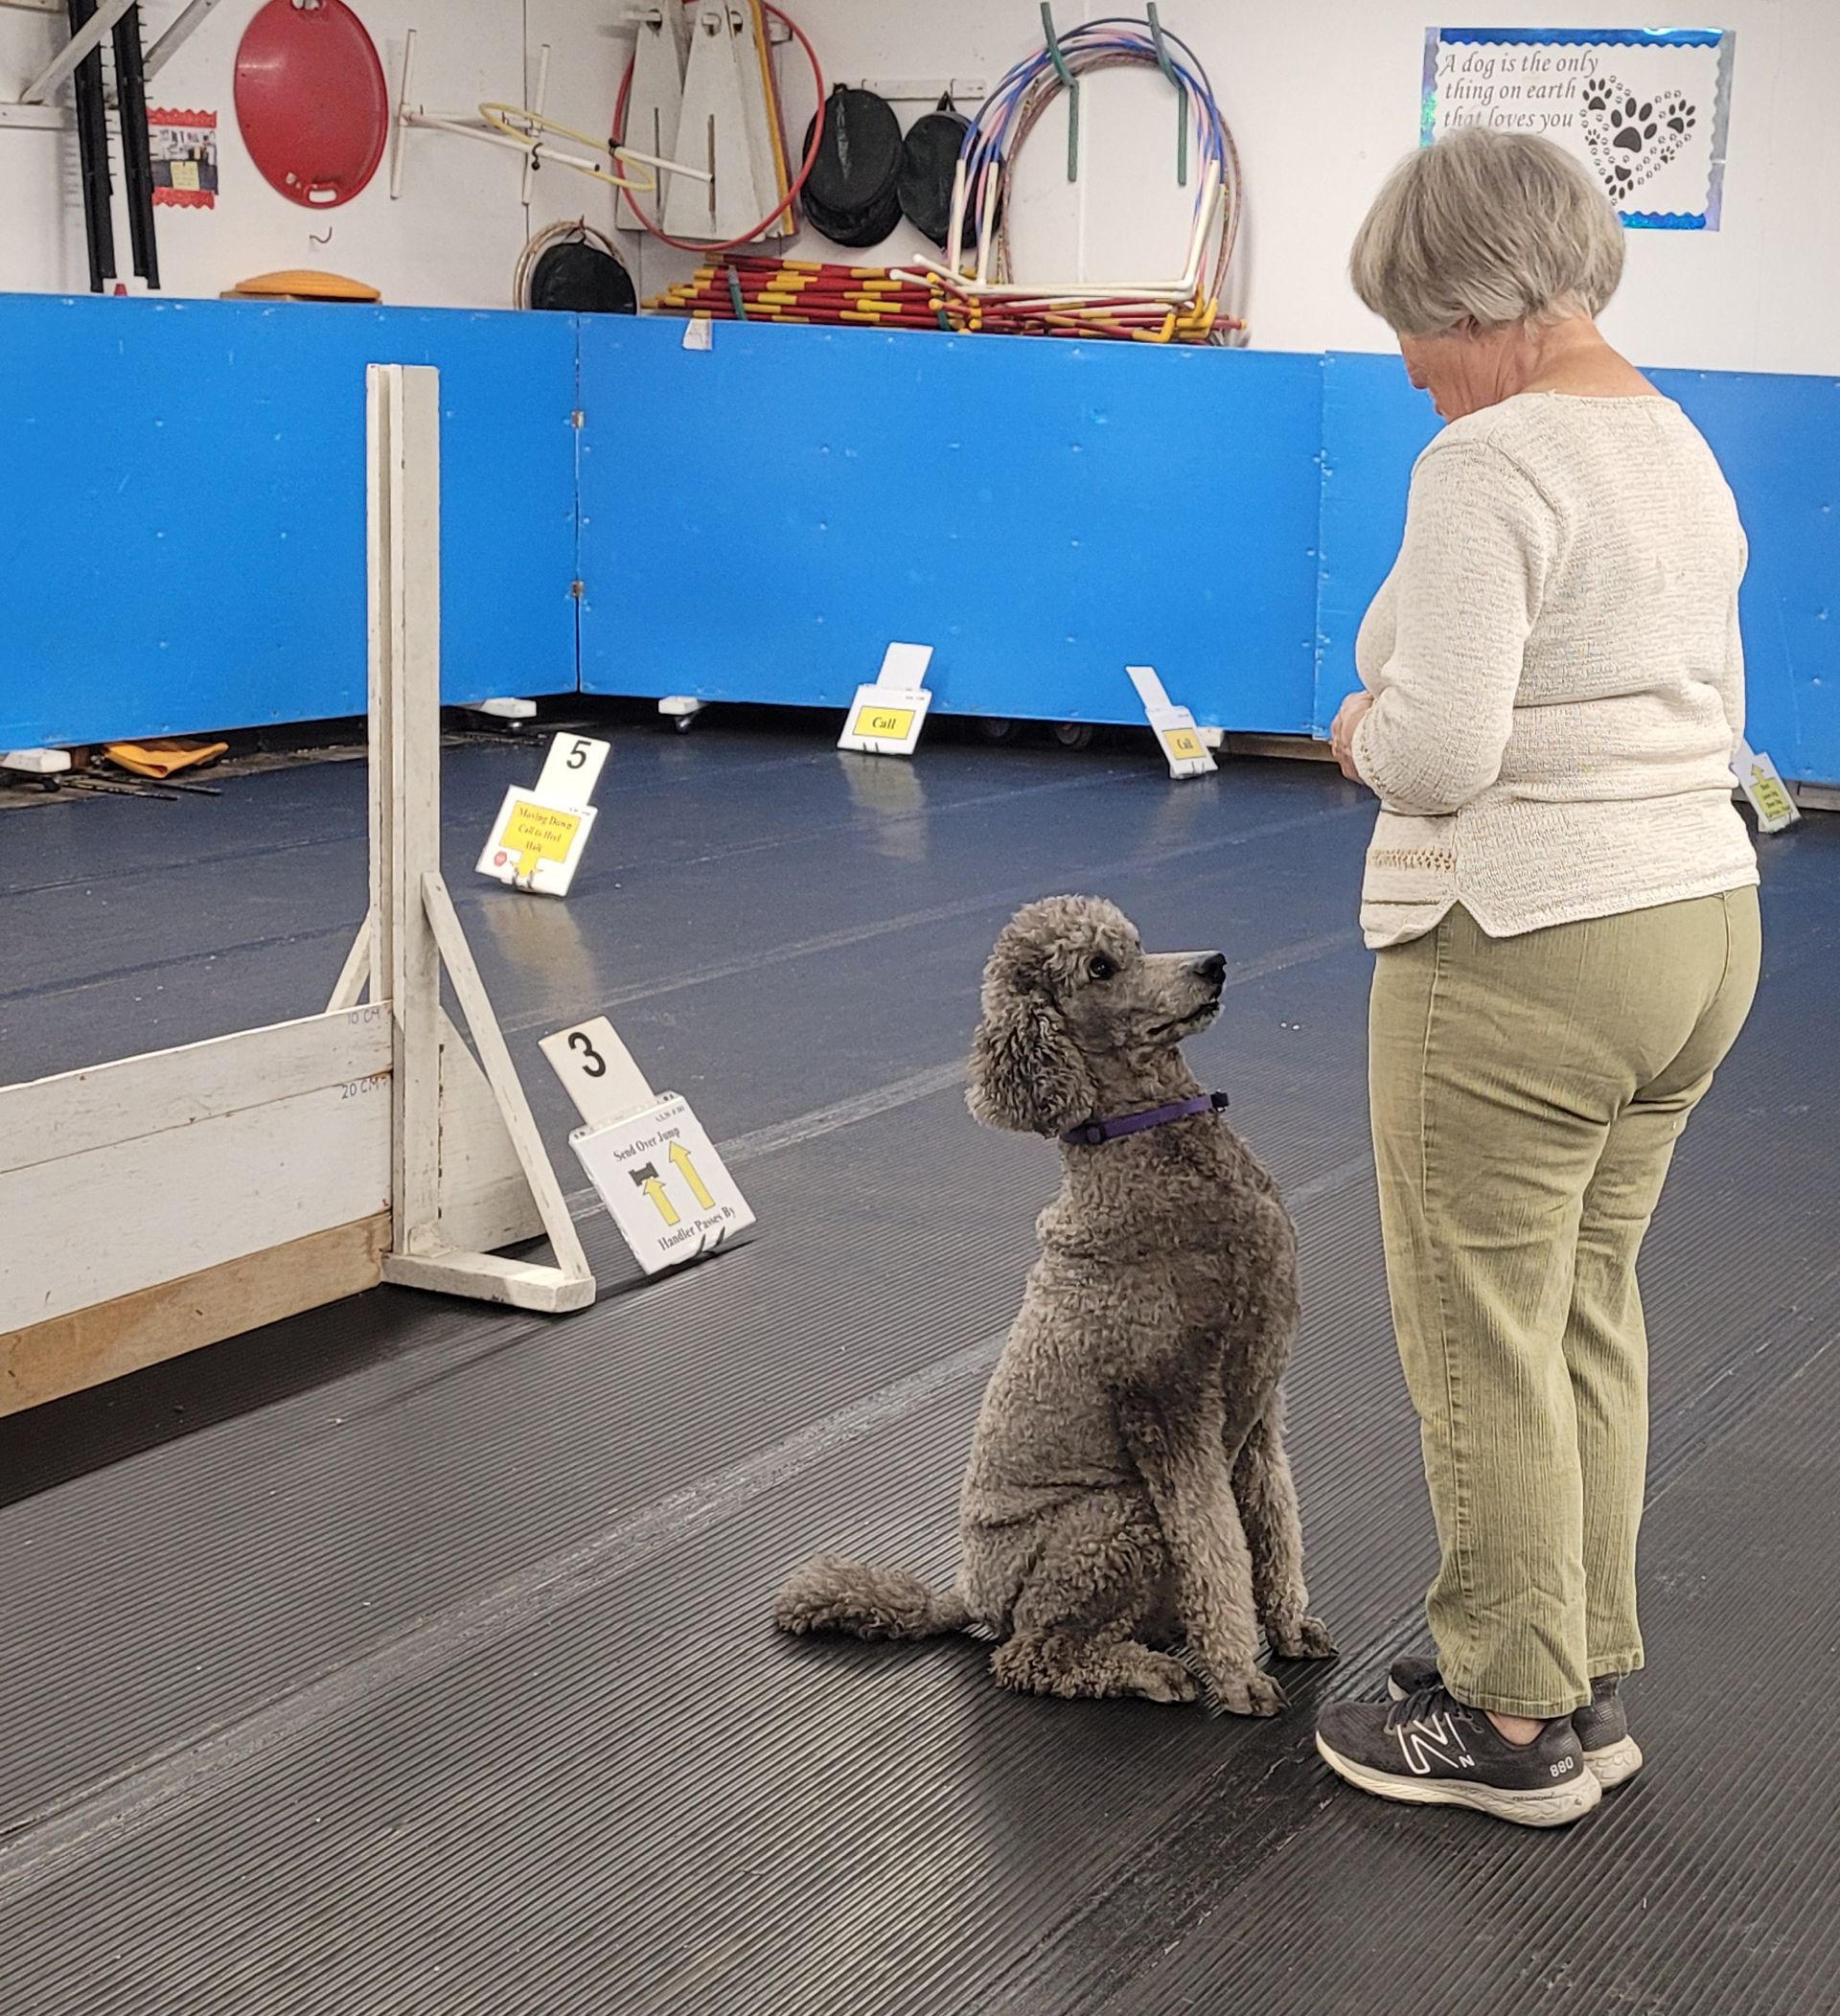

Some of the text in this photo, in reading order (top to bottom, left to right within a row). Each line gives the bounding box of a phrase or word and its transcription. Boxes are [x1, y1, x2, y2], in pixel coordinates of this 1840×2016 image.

[1438, 50, 1598, 80] A dog is the only
[1445, 77, 1577, 105] thing on earth
[1444, 105, 1574, 134] that loves you
[872, 717, 897, 730] Call
[566, 740, 592, 769] 5
[519, 808, 549, 825] Moving
[348, 1012, 359, 1025] 10
[567, 1031, 607, 1078] 3
[341, 1076, 380, 1100] 20 CM
[612, 1126, 681, 1163] Send Over Jump
[657, 1205, 736, 1251] Handler Passes By
[1549, 1755, 1574, 1777] 880
